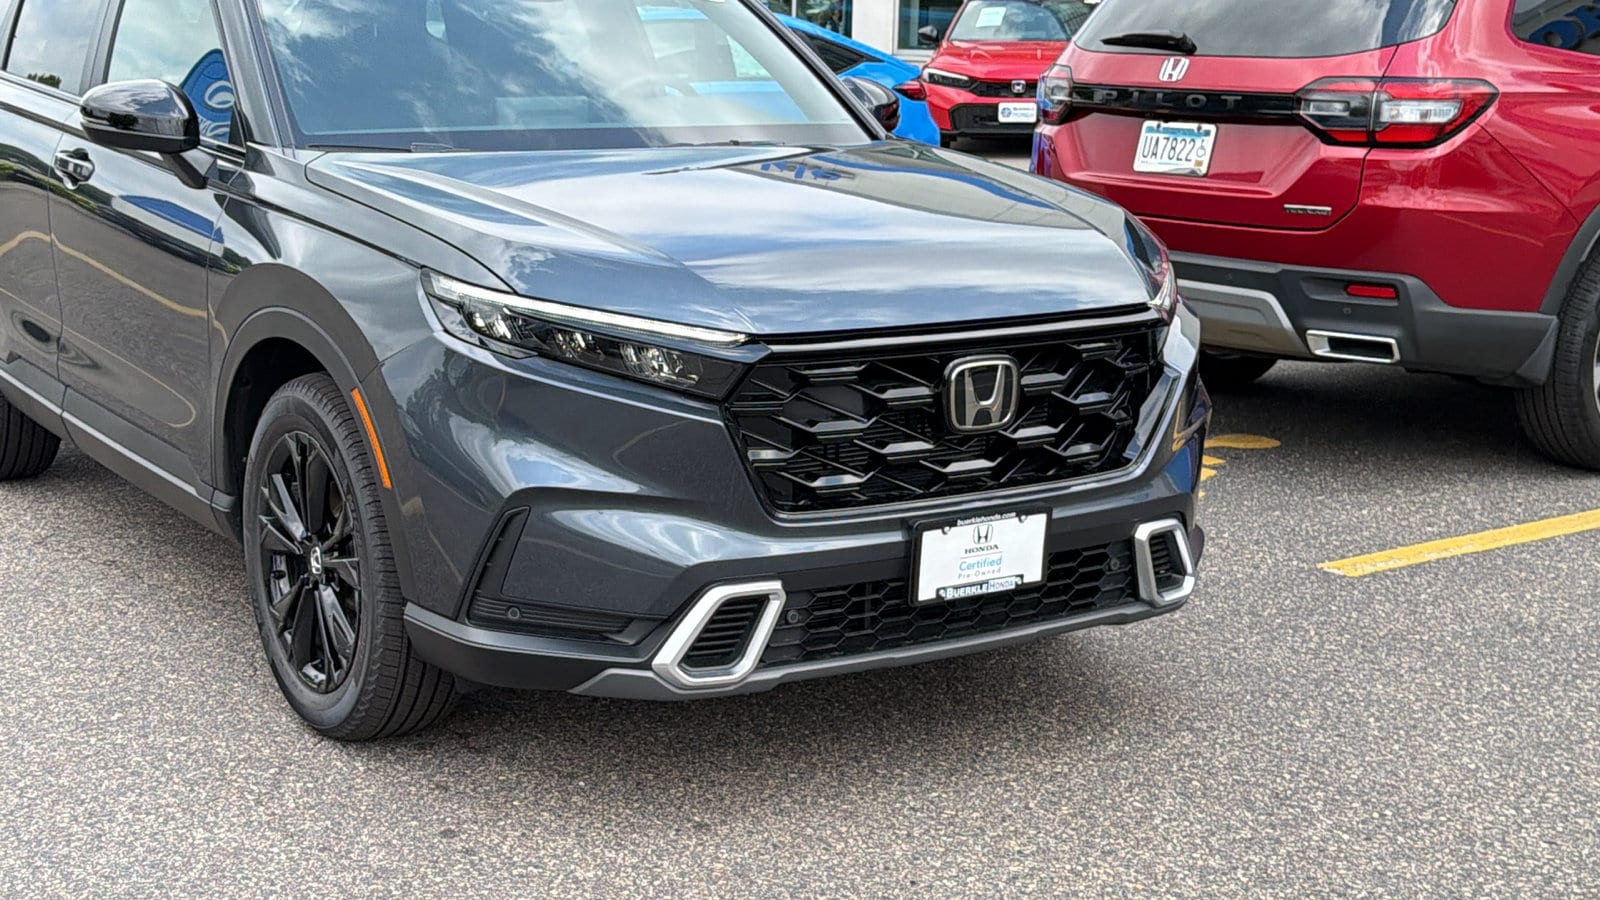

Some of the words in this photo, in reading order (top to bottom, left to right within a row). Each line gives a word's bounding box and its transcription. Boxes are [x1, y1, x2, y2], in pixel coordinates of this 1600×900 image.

[1093, 88, 1242, 109] PILOT
[1142, 136, 1196, 162] UA7822
[964, 544, 999, 554] HONDA
[959, 555, 1003, 571] Certified
[958, 566, 1001, 579] Pre-Owned
